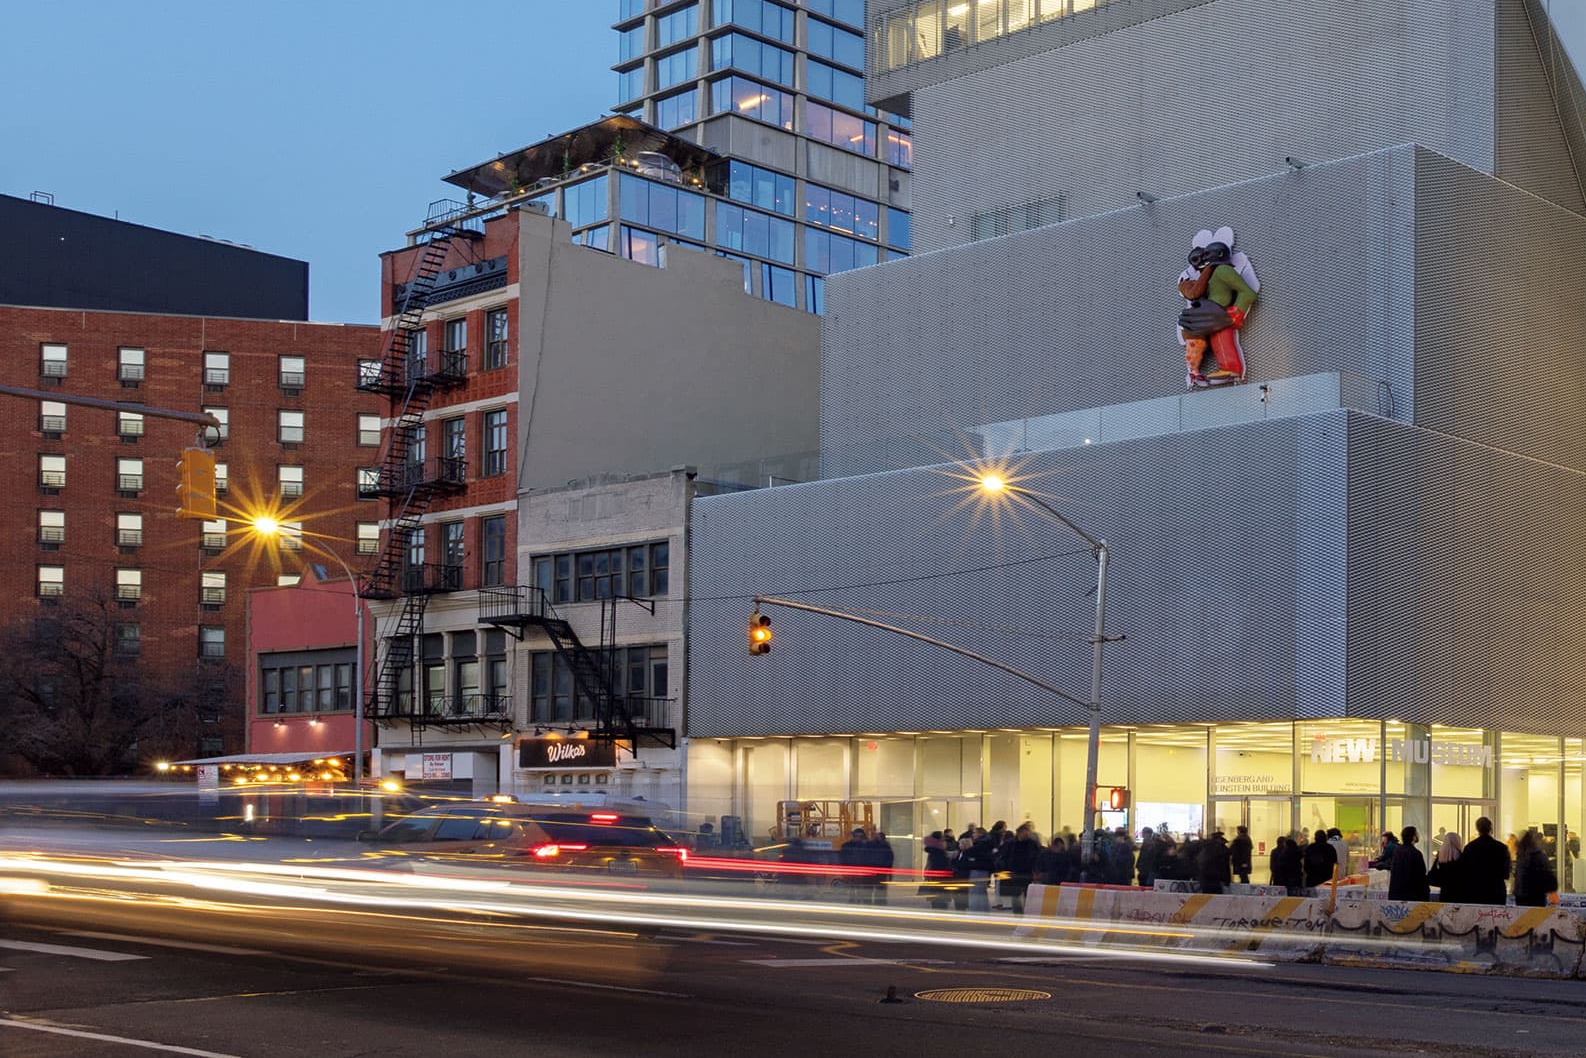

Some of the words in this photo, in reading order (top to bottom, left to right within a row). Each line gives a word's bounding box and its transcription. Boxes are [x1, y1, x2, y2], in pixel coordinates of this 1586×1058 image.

[1311, 738, 1376, 763] NEW
[1391, 738, 1492, 768] MUSEUM
[1252, 784, 1291, 792] BUILDING
